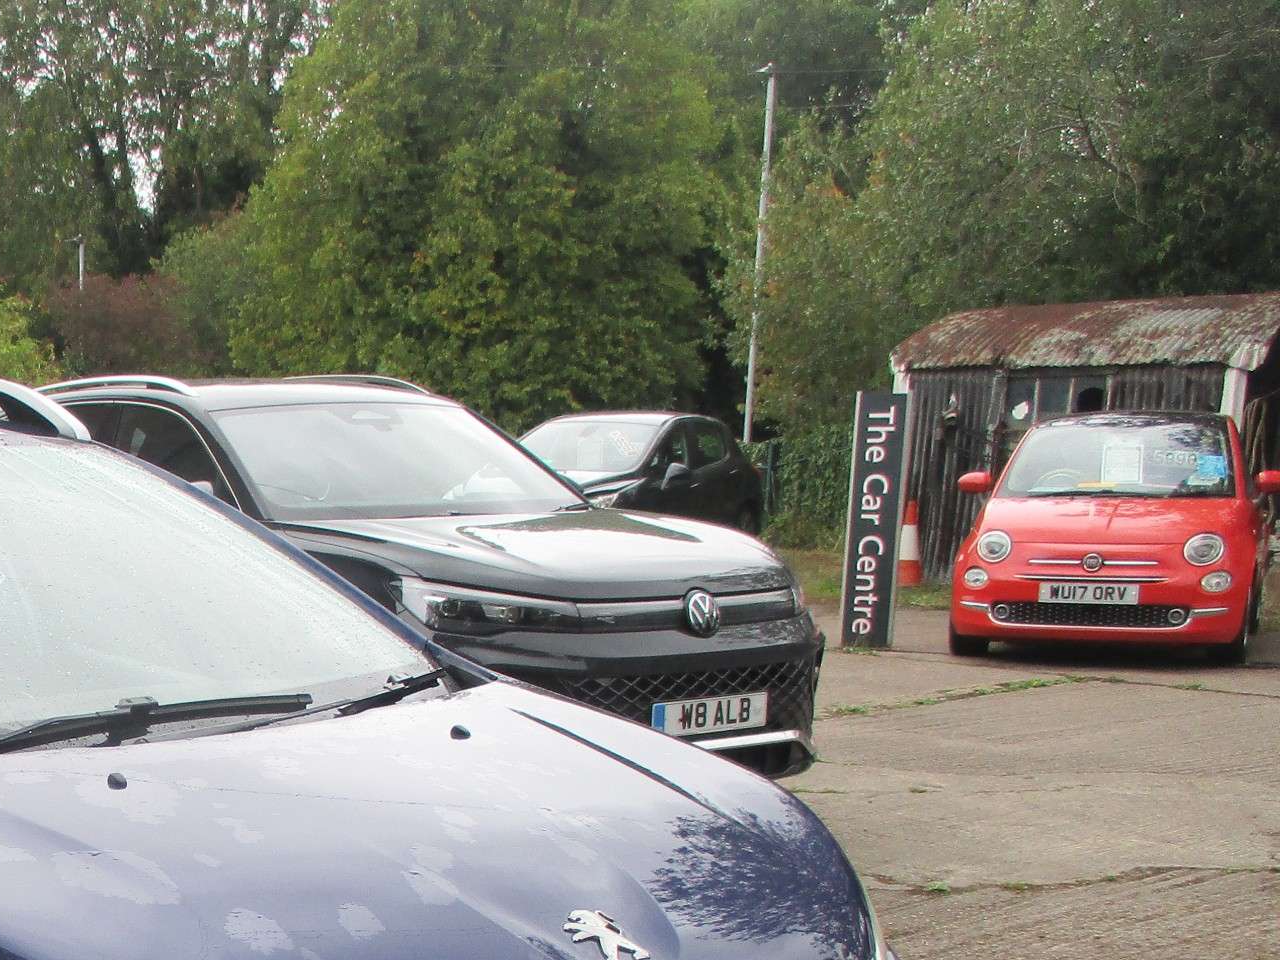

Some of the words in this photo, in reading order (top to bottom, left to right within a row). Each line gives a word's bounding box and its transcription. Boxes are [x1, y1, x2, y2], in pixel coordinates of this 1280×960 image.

[864, 406, 897, 463] The
[861, 474, 889, 526] Car
[852, 535, 884, 635] Centre
[1050, 585, 1088, 600] WU17
[1093, 586, 1127, 601] ORV
[681, 703, 707, 729] W8
[713, 698, 751, 726] ALB
